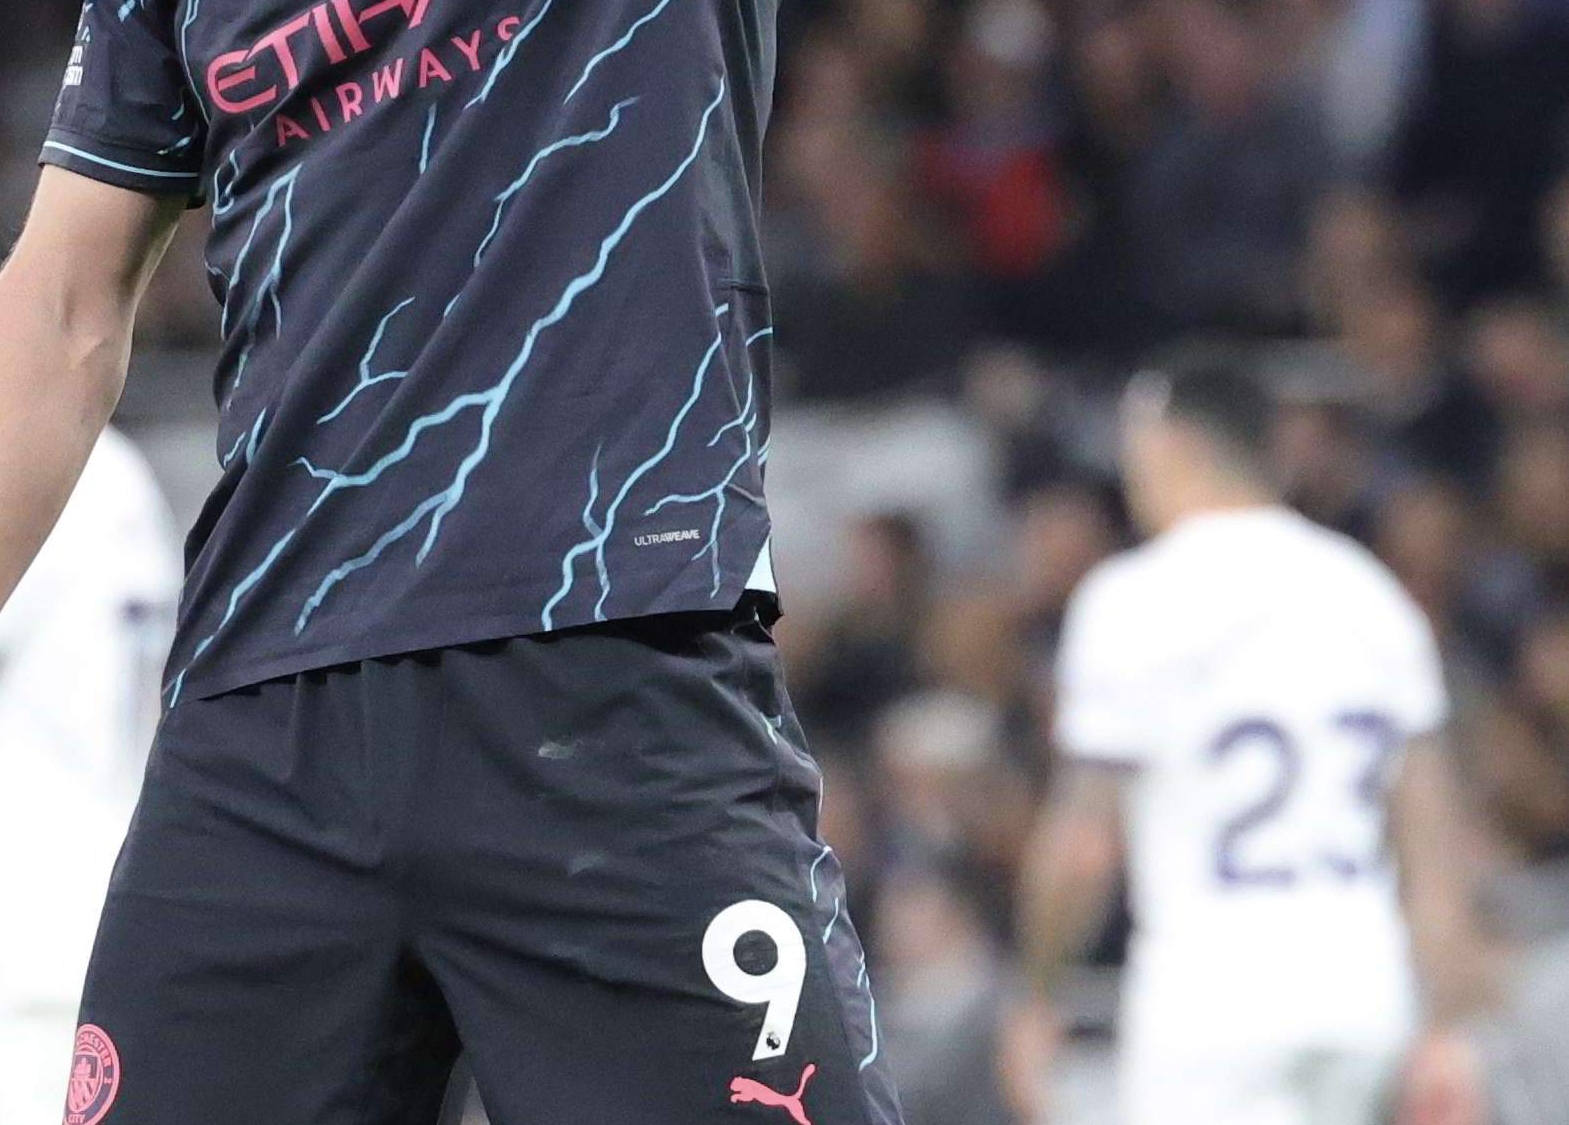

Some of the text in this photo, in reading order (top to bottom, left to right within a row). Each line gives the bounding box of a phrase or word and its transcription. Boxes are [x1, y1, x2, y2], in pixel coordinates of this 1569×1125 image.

[634, 529, 700, 546] ULTRAWEAVE
[1204, 711, 1408, 887] 23
[702, 899, 807, 1061] 9
